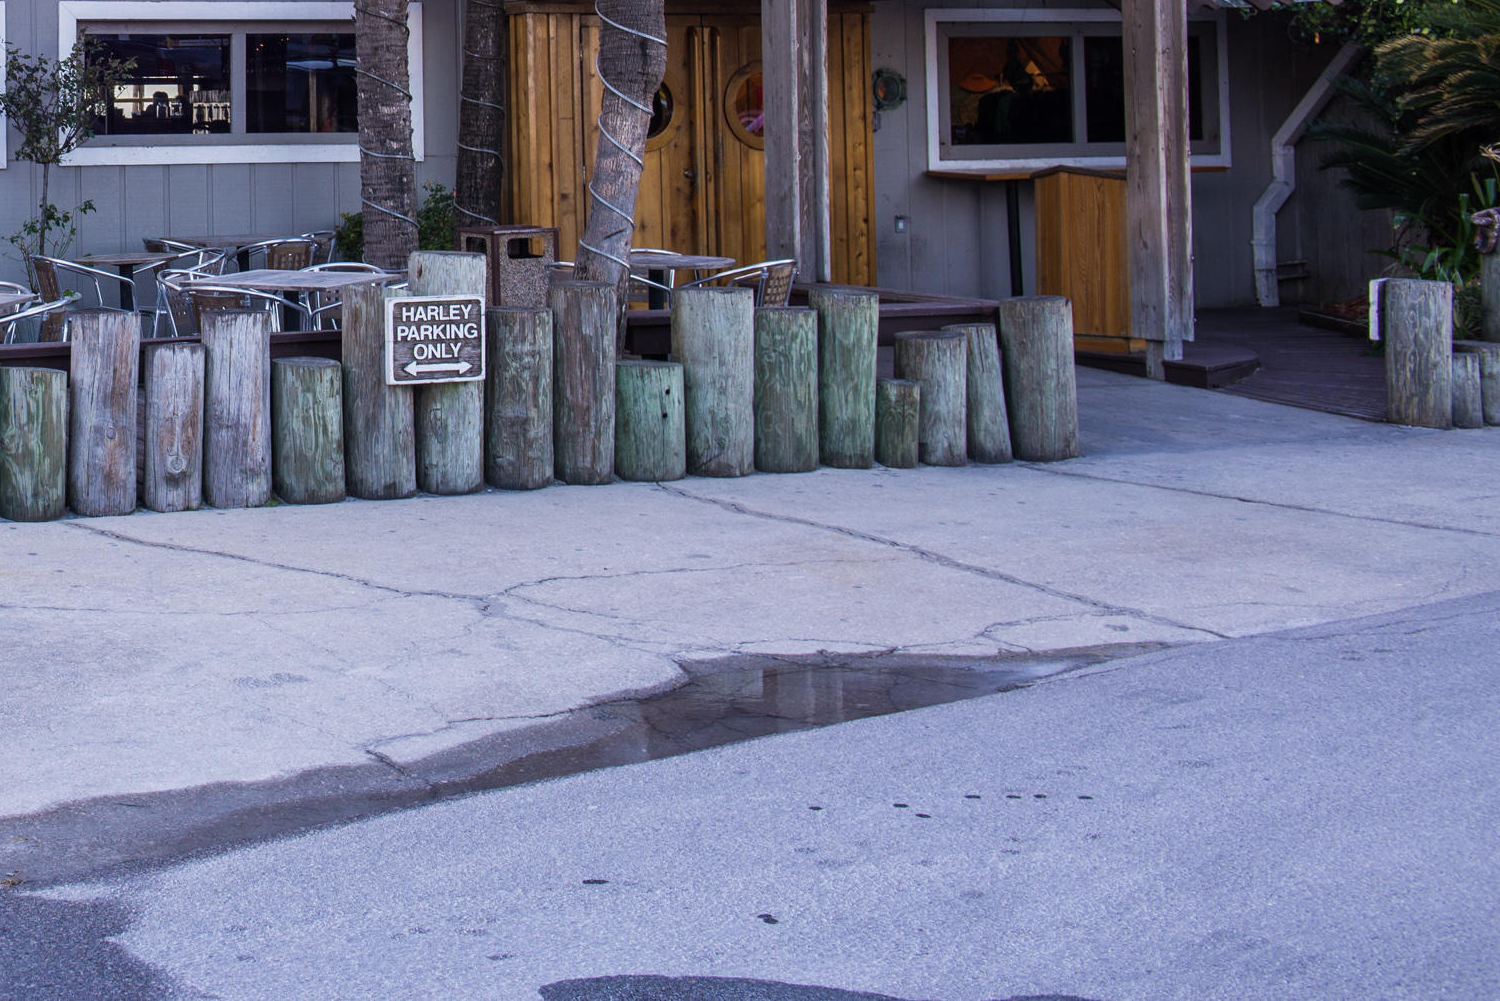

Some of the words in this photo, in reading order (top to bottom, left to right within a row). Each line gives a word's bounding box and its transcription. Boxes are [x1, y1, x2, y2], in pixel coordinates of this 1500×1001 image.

[402, 304, 472, 322] HARLEY
[397, 323, 478, 341] PARKING
[413, 342, 462, 360] ONLY
